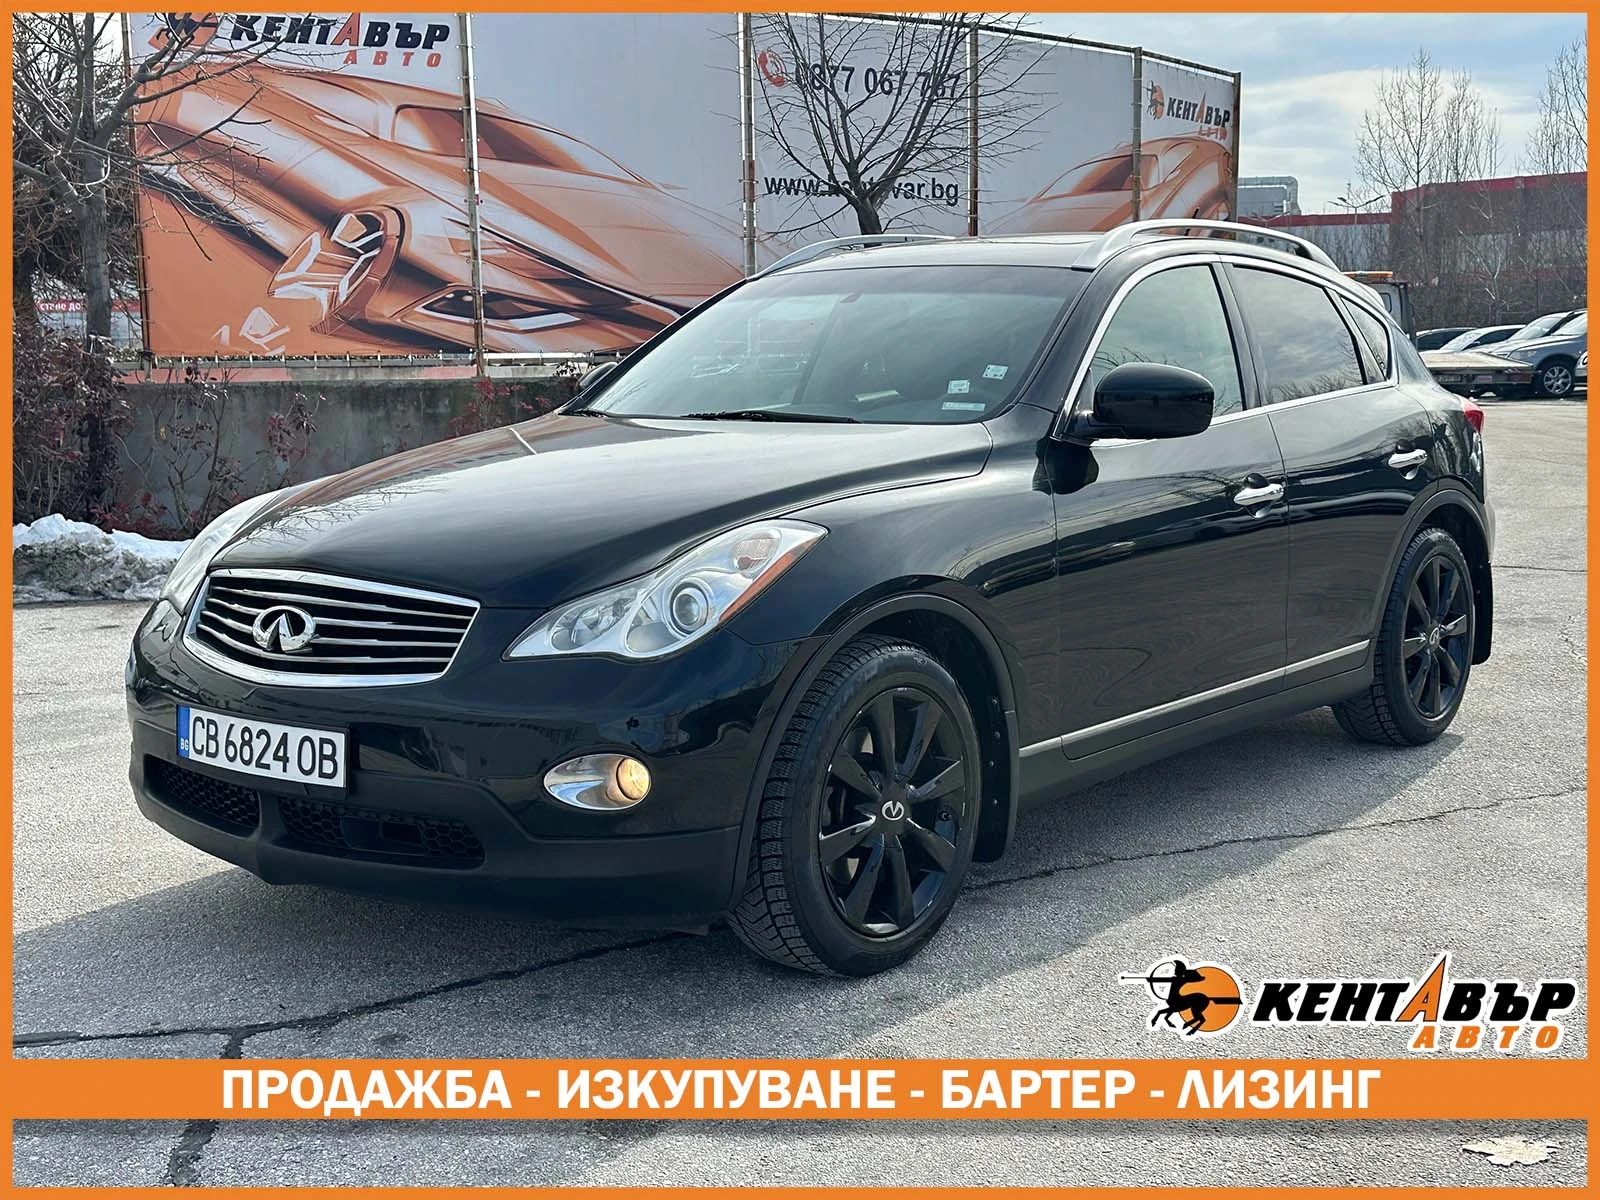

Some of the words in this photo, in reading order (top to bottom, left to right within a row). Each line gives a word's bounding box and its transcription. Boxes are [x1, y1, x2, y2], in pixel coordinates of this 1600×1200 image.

[230, 13, 450, 50] КЕНТАВЪР
[343, 50, 442, 67] АВТО
[864, 67, 908, 95] 067
[1167, 91, 1231, 128] КЕНТАВЪР
[764, 176, 960, 206] www.var.bg
[180, 738, 189, 751] BG
[192, 715, 220, 759] CB
[225, 723, 290, 774] 6824
[297, 735, 339, 780] OB
